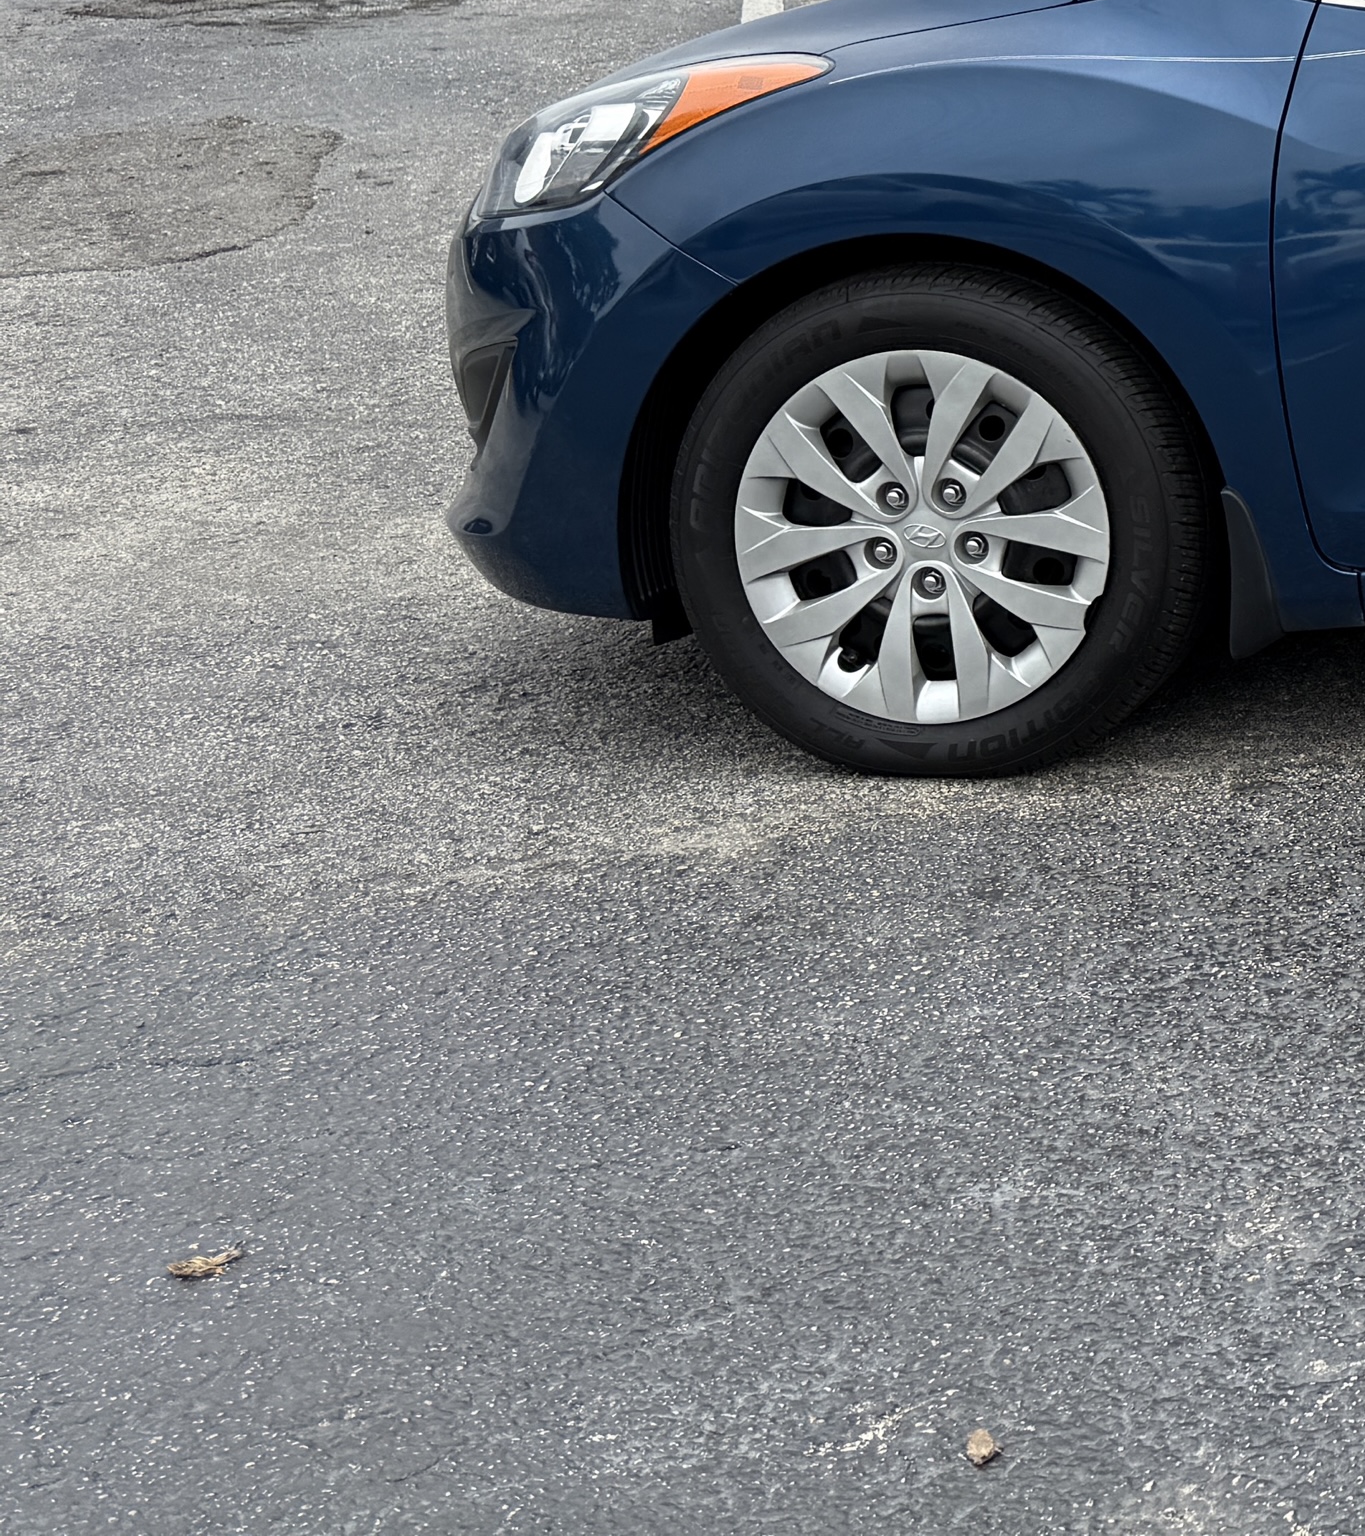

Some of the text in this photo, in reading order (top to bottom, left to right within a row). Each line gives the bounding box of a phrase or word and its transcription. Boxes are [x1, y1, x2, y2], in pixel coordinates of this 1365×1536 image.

[947, 494, 1153, 764] SILVER EDITION
[804, 716, 865, 752] ALL
